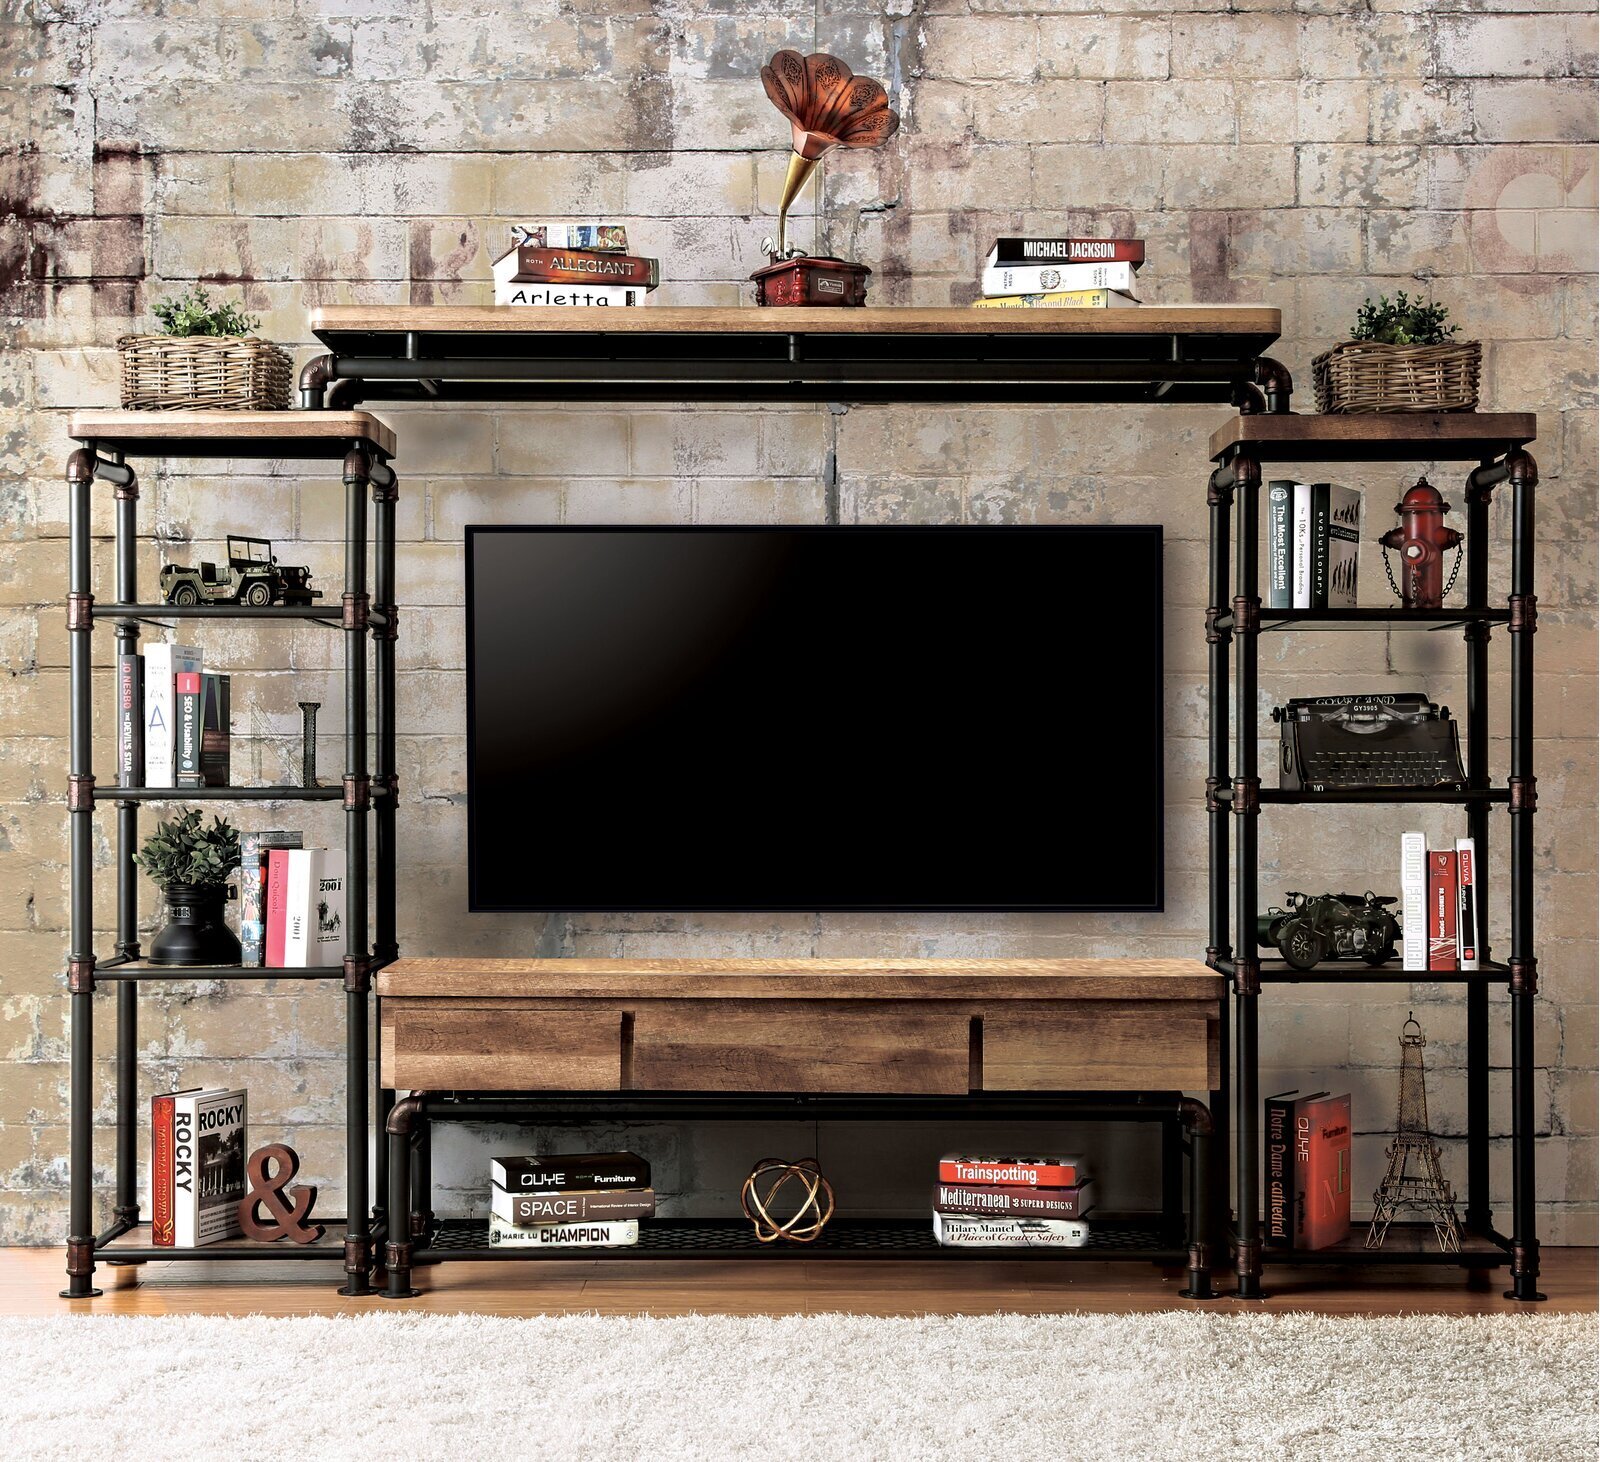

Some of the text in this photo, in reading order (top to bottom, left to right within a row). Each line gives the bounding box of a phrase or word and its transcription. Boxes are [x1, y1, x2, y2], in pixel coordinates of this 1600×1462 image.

[1023, 241, 1115, 258] MICHAEL JACKSON
[550, 257, 635, 276] ALLEGIANT
[511, 290, 609, 306] Arletta
[1277, 504, 1286, 522] The
[1277, 524, 1286, 546] Most
[1316, 512, 1324, 595] evolutionary
[1278, 548, 1286, 590] Excellent
[122, 662, 132, 673] JO
[184, 696, 193, 715] SEO
[124, 721, 132, 750] DEVIL'S
[182, 722, 193, 759] Usability
[319, 882, 341, 892] 2001
[292, 916, 301, 940] 2001
[200, 1104, 243, 1131] ROCKY
[1298, 1117, 1309, 1162] OUYE
[176, 1112, 192, 1193] ROCKY
[1271, 1144, 1286, 1178] Dame
[521, 1173, 565, 1186] OUYE
[594, 1175, 636, 1183] Furniture
[158, 1178, 167, 1219] CROWN
[520, 1200, 578, 1217] SPACE
[940, 1187, 1010, 1209] Mediterranean
[1021, 1199, 1044, 1208] SUPERB
[1046, 1200, 1073, 1210] DESIGNS
[1271, 1181, 1286, 1238] cathedral
[541, 1228, 610, 1242] CHAMPION
[946, 1224, 1015, 1233] Hilary Mantel
[1034, 1234, 1067, 1243] Safety
